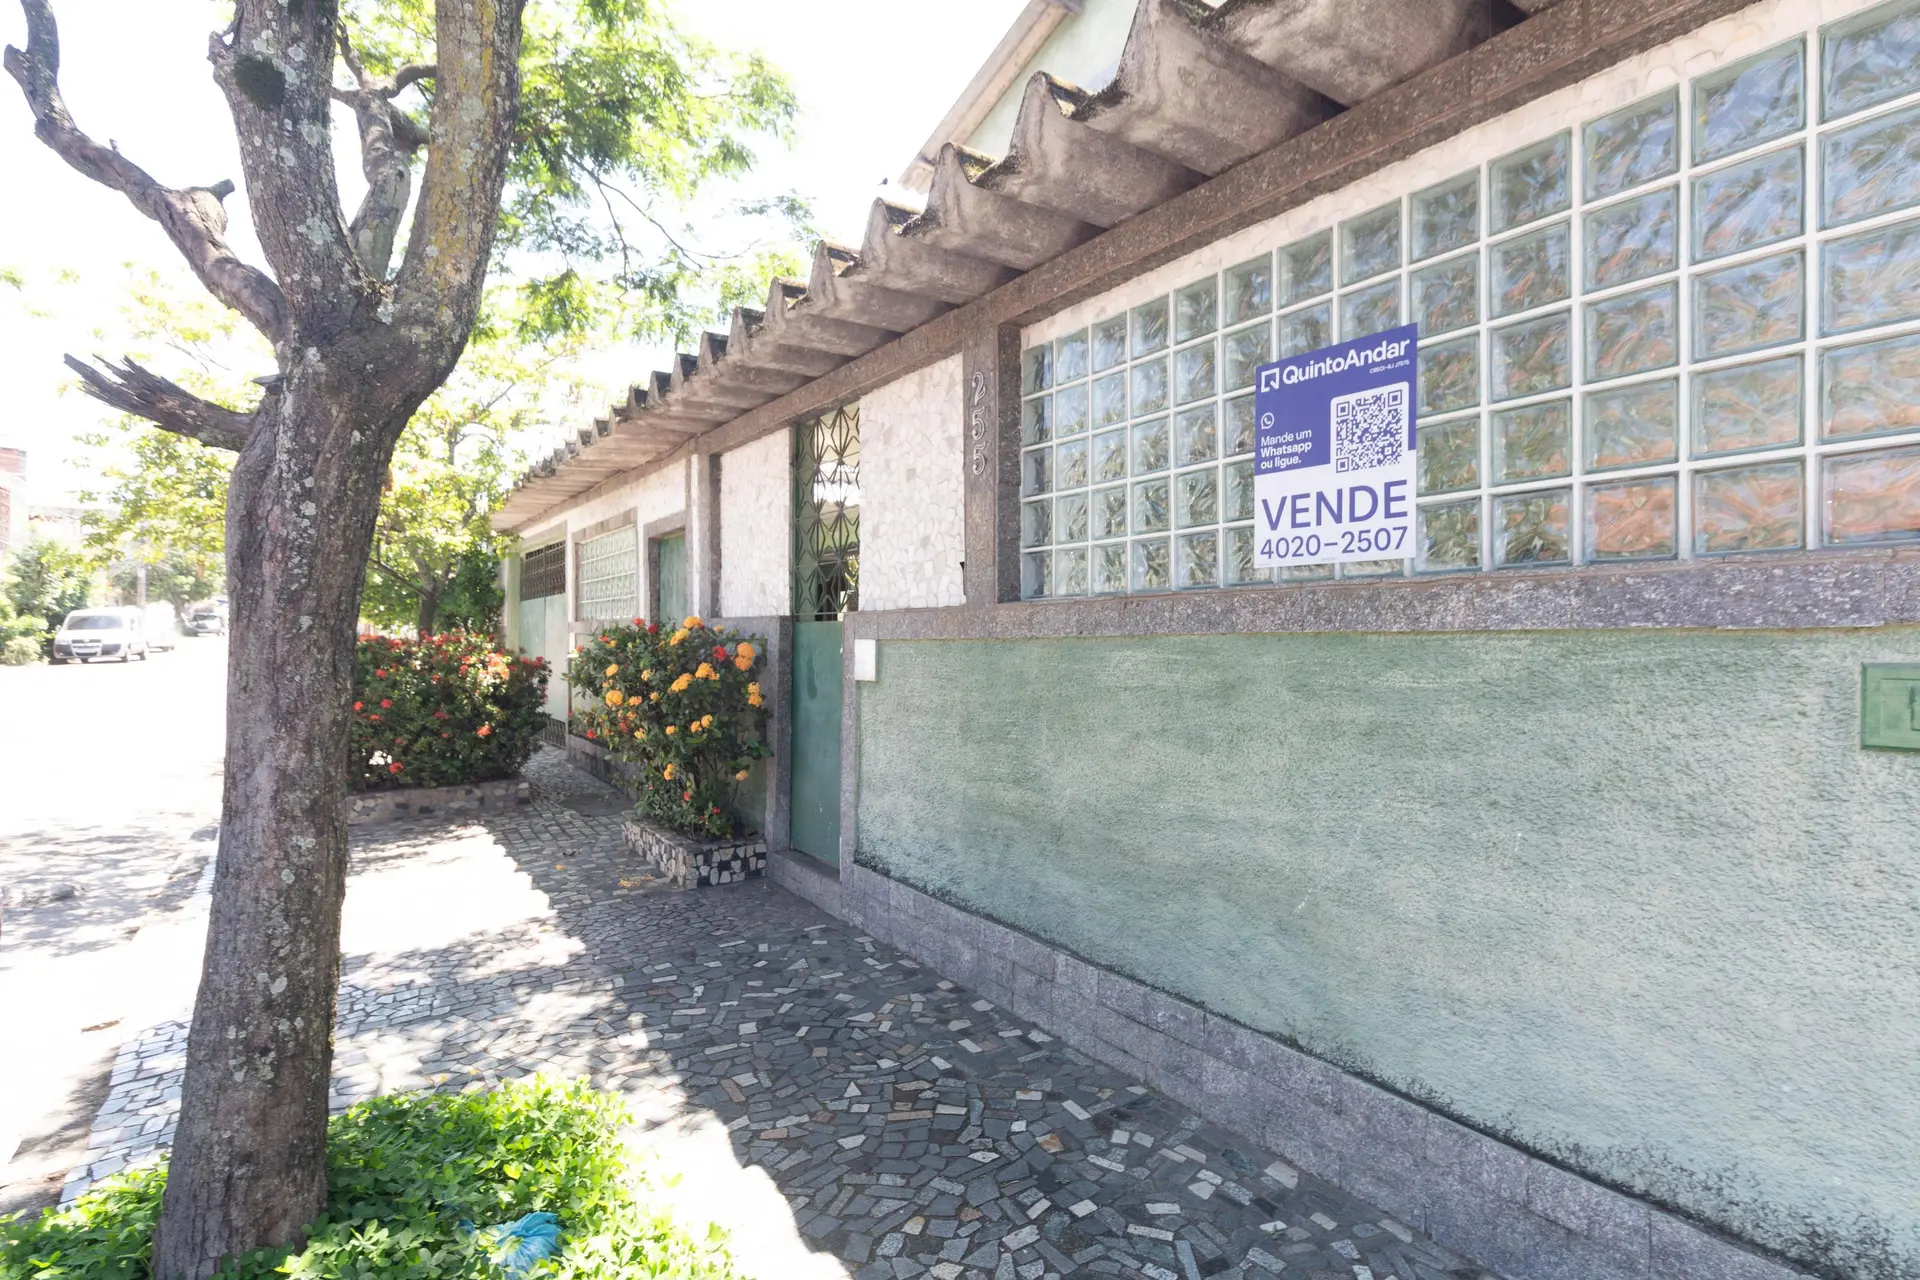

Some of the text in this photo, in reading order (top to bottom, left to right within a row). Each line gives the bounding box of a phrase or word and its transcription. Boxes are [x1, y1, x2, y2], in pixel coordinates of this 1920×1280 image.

[1282, 338, 1410, 385] QuintoAndar
[971, 371, 986, 475] 255
[1261, 429, 1312, 447] Mande um
[1260, 441, 1312, 458] Whatsapp
[1260, 455, 1302, 469] ou ligue.
[1261, 479, 1408, 531] VENDE
[1260, 526, 1408, 560] 4020-2507
